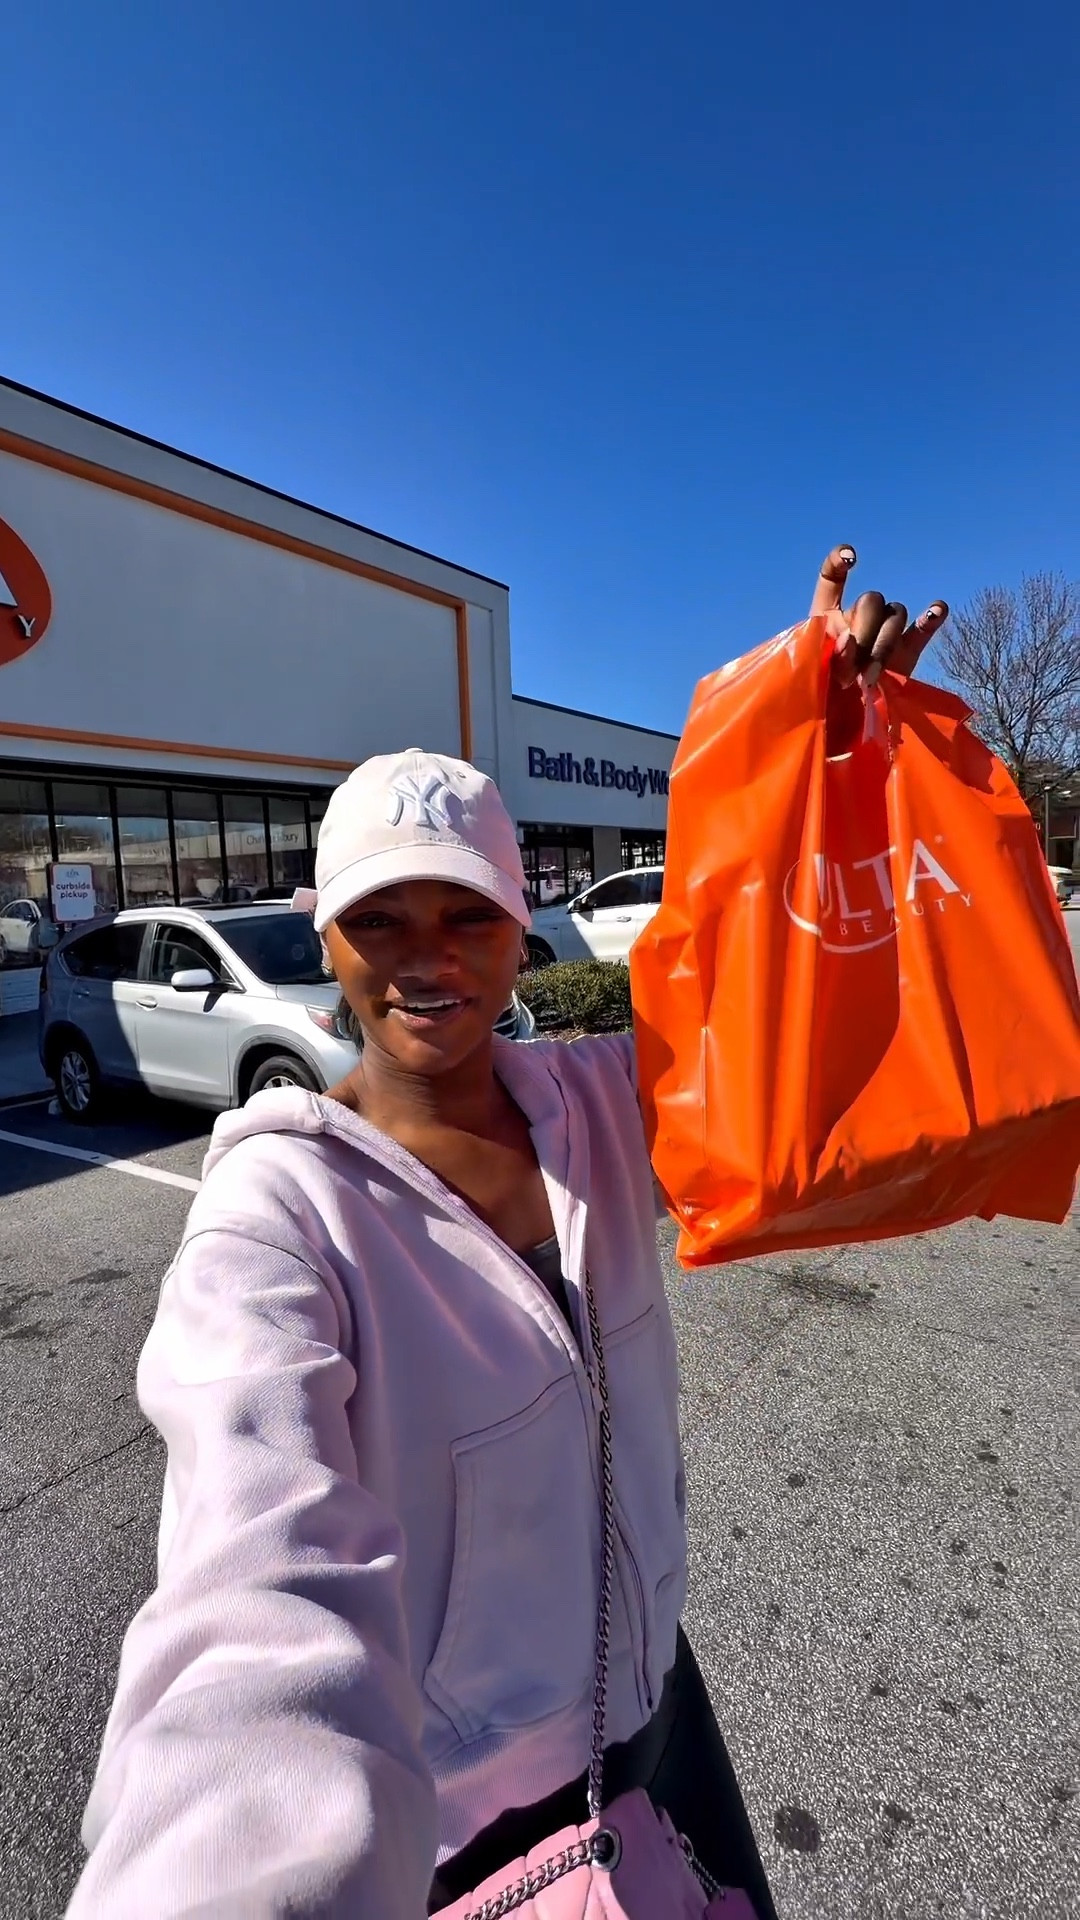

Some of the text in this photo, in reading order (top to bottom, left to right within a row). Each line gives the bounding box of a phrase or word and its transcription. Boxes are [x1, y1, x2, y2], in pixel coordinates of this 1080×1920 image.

[528, 746, 582, 783] Bath
[583, 757, 599, 787] &
[600, 759, 648, 798] Body
[385, 775, 453, 830] NY
[56, 882, 91, 890] curbside
[60, 891, 88, 899] pickup
[814, 838, 961, 920] ULTA
[839, 893, 973, 936] BEAUTY
